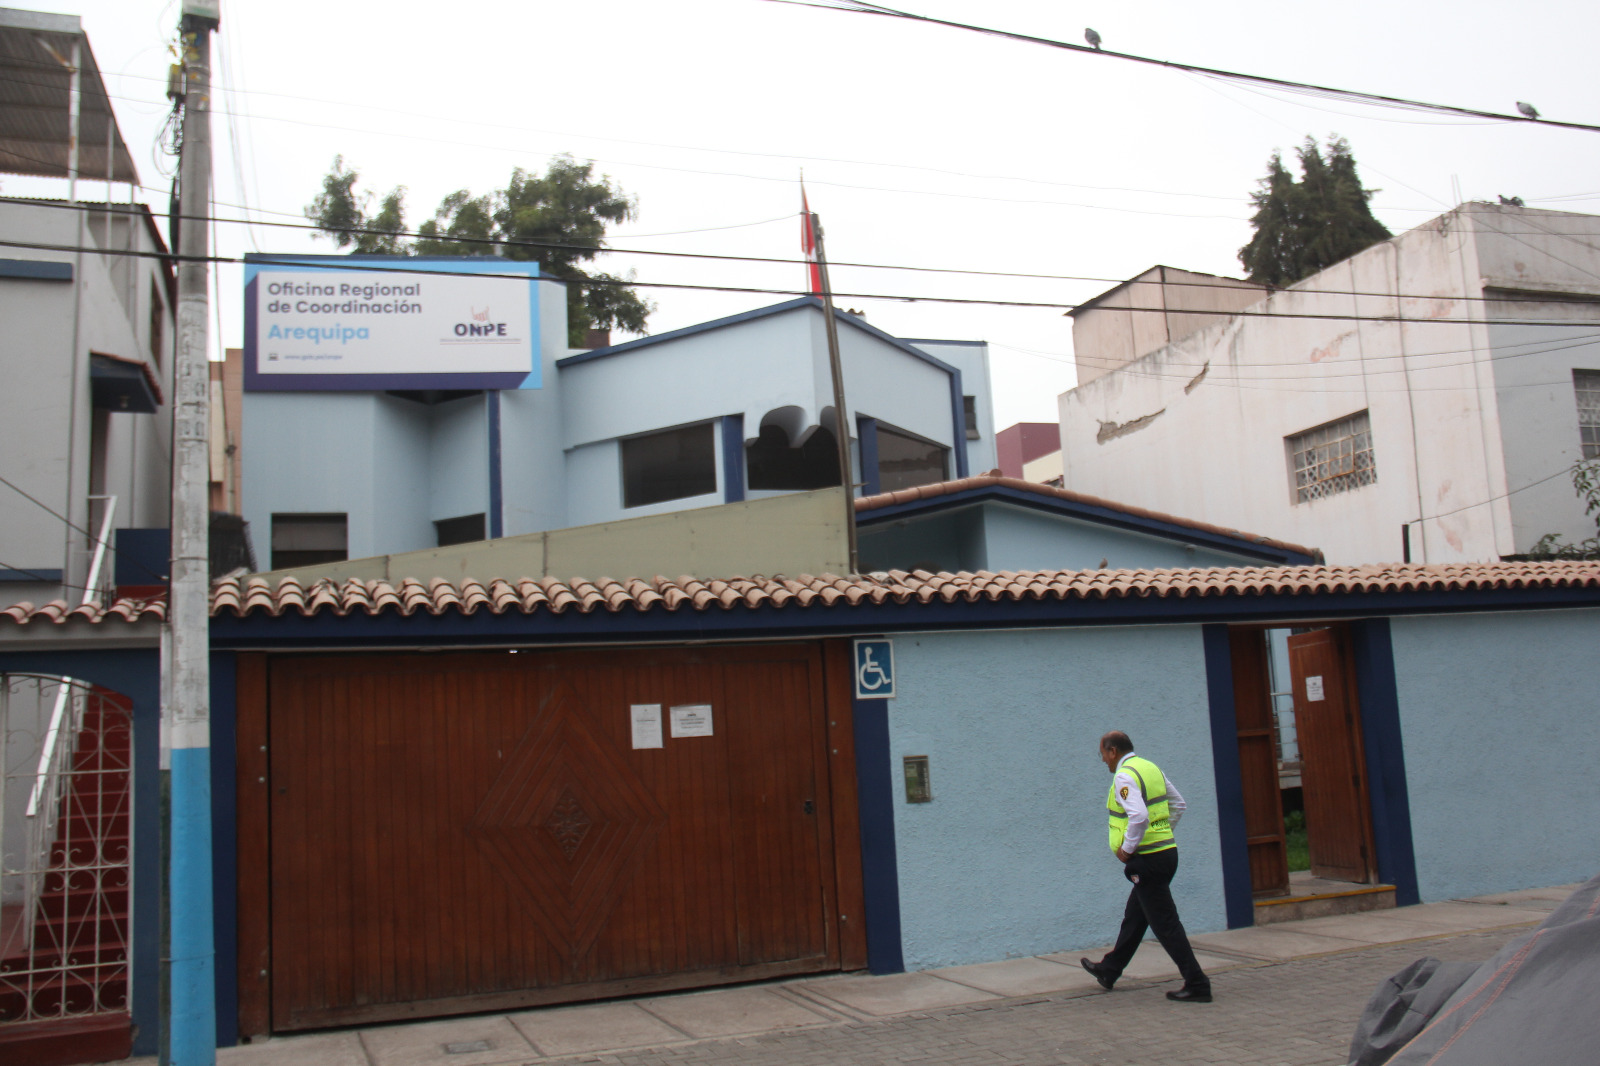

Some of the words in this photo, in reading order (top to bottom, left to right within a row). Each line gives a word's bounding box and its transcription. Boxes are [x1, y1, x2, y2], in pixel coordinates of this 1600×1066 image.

[267, 282, 335, 296] Oficina
[340, 282, 420, 300] Regional
[267, 300, 291, 313] de
[295, 299, 422, 313] Coordinación
[267, 323, 369, 345] Arequipa
[454, 323, 507, 336] ONPE
